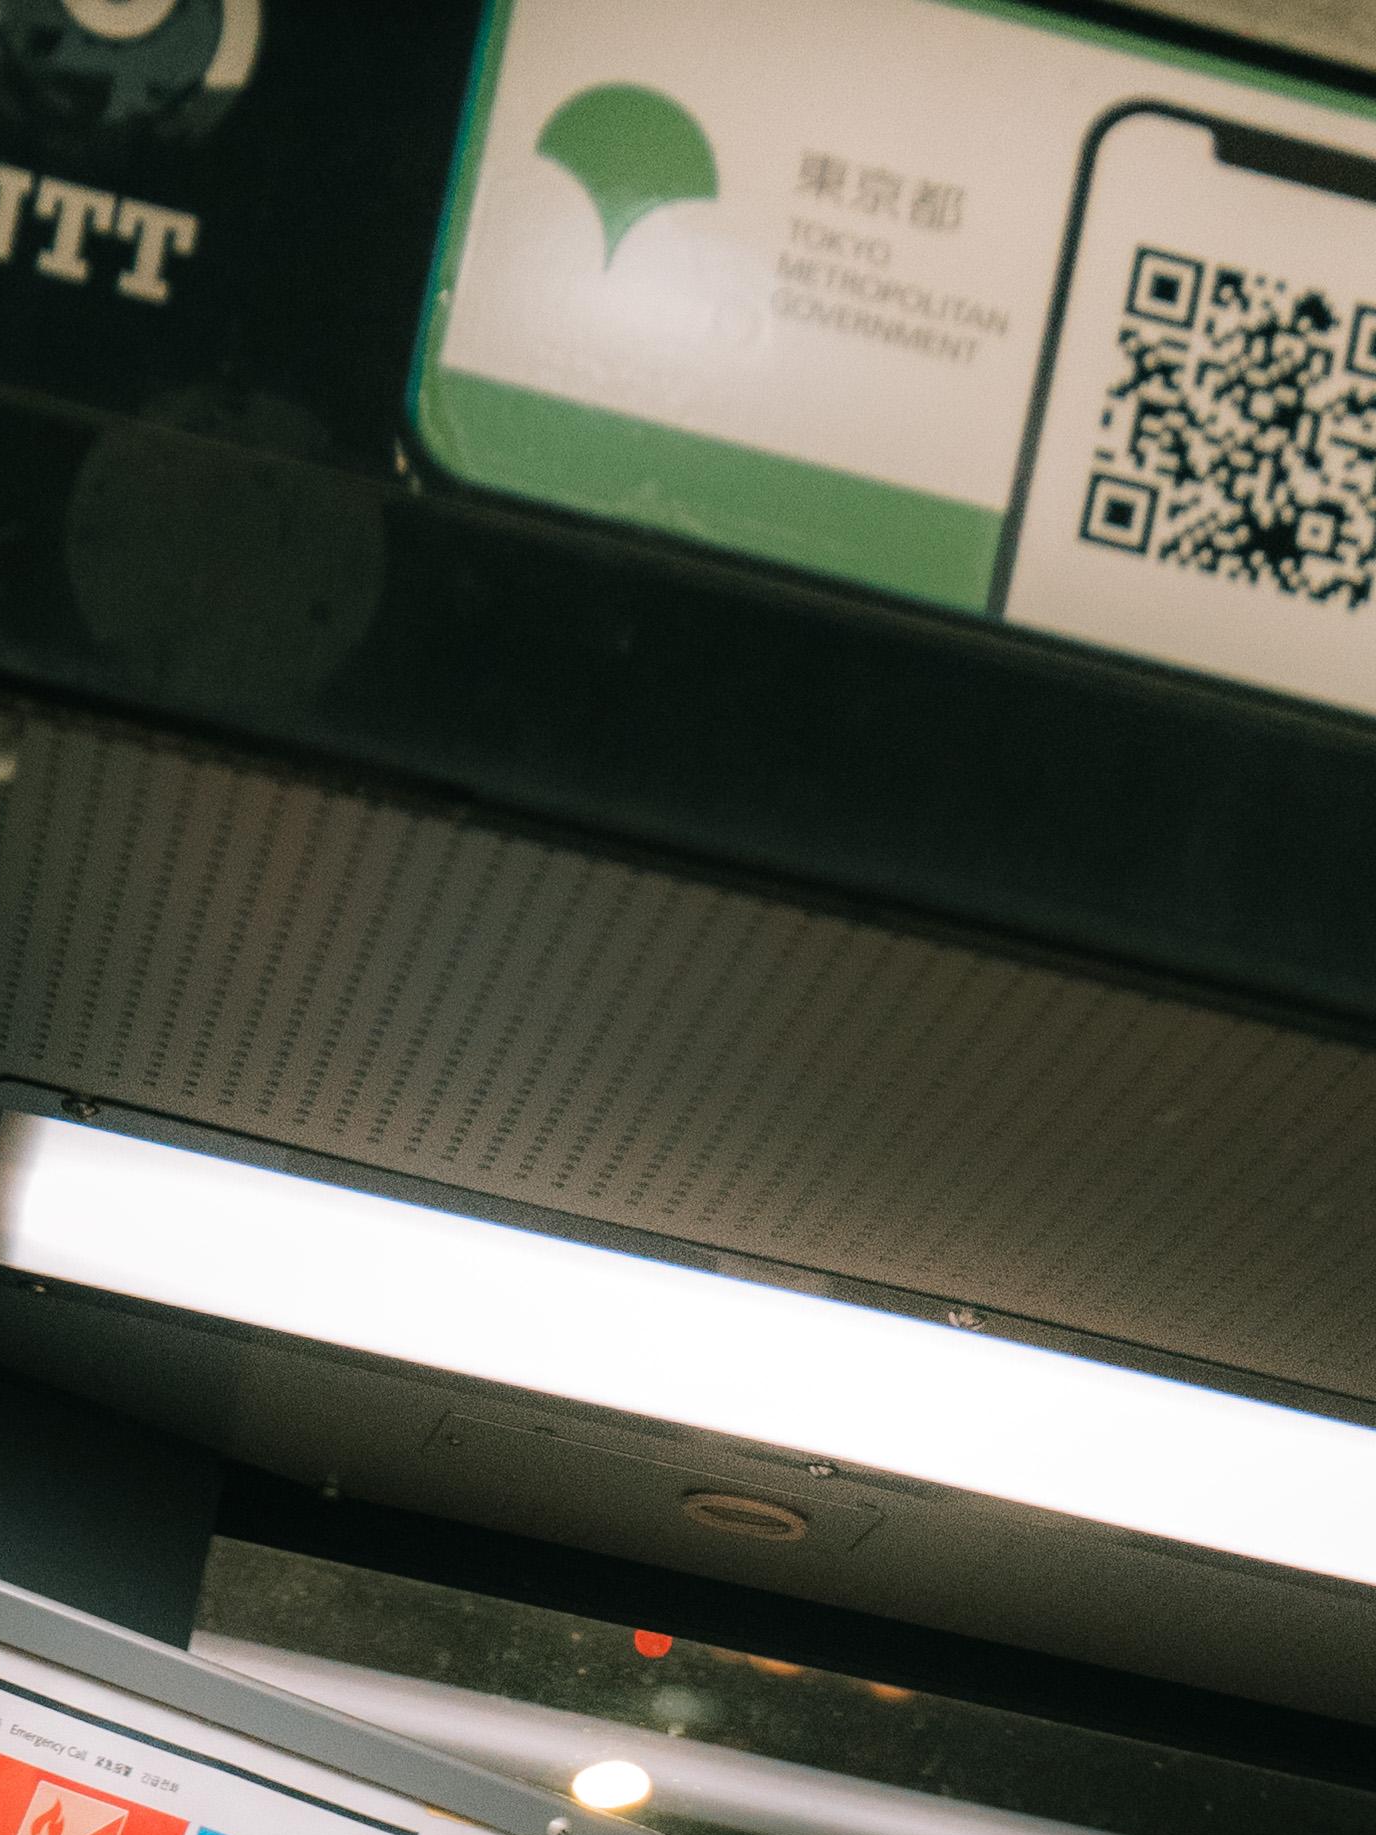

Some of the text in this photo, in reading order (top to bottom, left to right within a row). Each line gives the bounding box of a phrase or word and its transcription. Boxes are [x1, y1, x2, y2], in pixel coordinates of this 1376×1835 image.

[792, 150, 964, 233] 東京都
[789, 216, 891, 269] TOKYO
[771, 287, 978, 362] GOVERNMENT
[777, 252, 1009, 337] METROPOLITAN
[10, 1724, 87, 1762] Emergency Call
